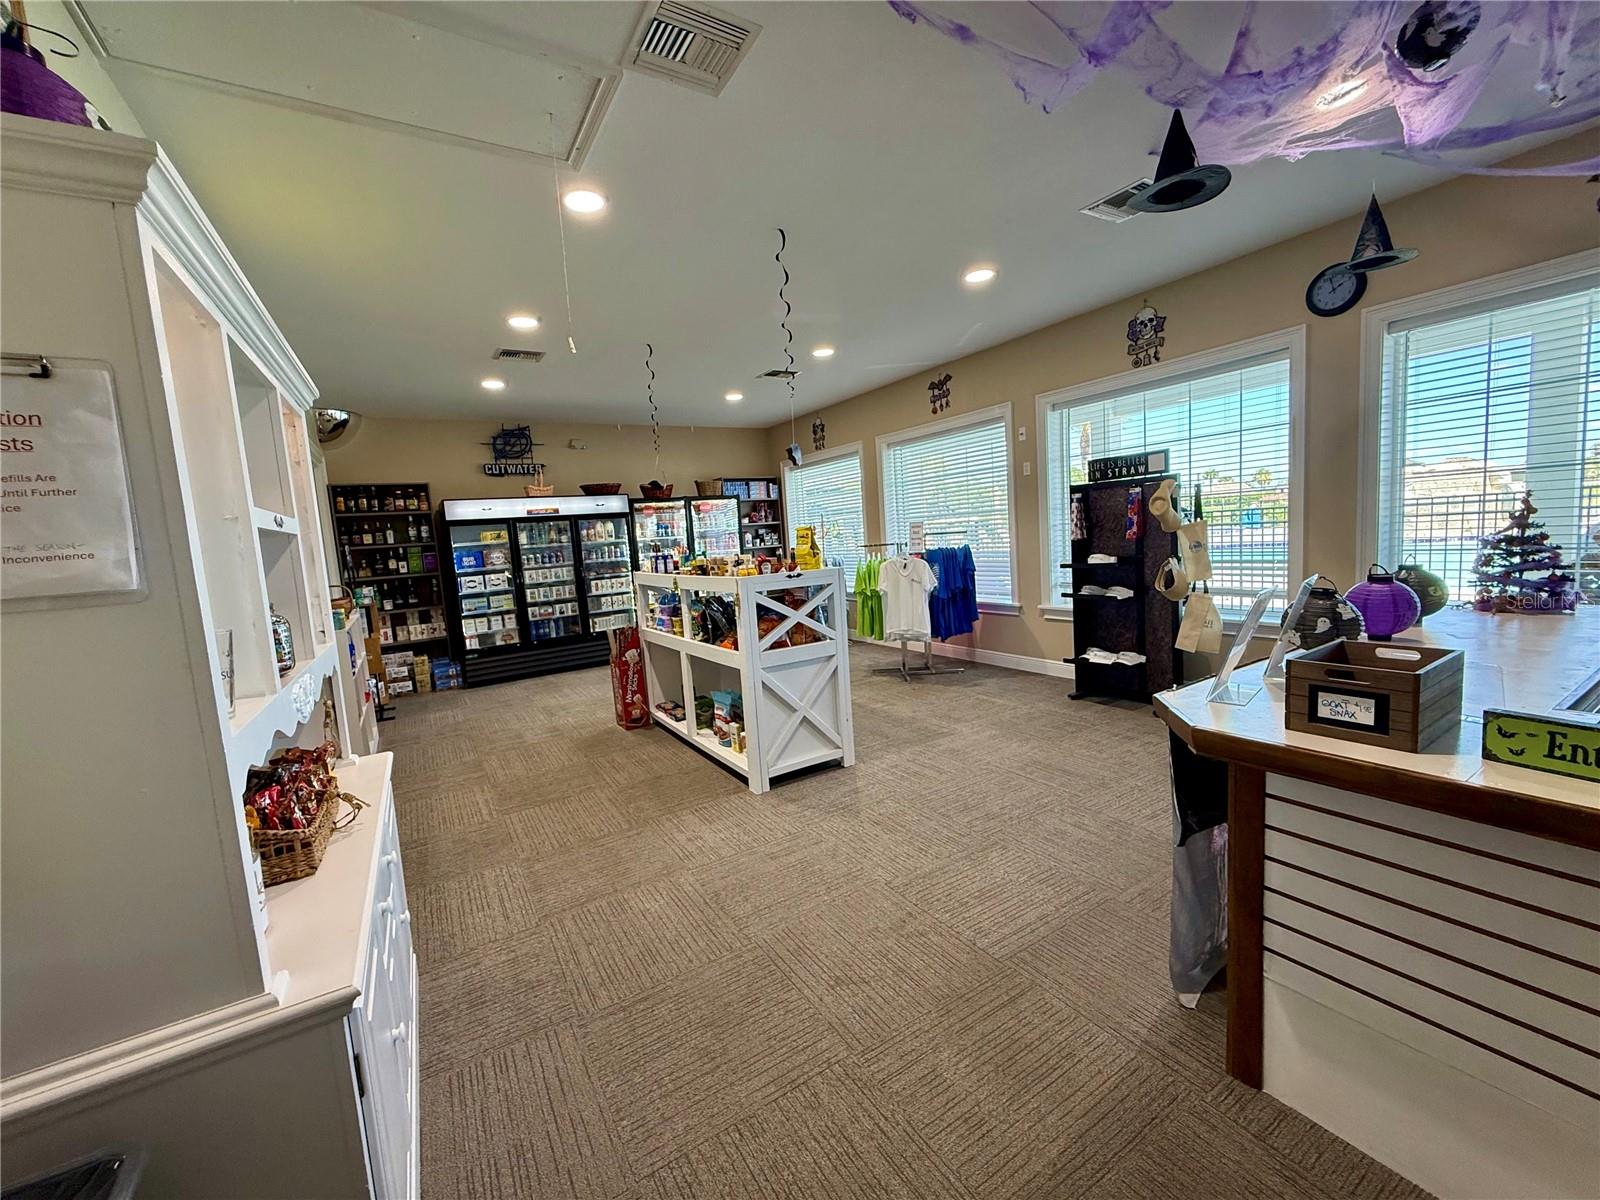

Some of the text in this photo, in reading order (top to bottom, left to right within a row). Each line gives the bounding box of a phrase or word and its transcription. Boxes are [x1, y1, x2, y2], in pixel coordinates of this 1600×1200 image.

[484, 464, 543, 474] CUTWATER
[1090, 456, 1146, 471] LIFE IS BETTER
[34, 474, 57, 483] Are
[1090, 465, 1146, 480] IN STRAW
[31, 488, 78, 497] Further
[2, 551, 95, 565] Inconvenience
[625, 662, 635, 703] Marshmallow
[1329, 707, 1358, 720] SNAX
